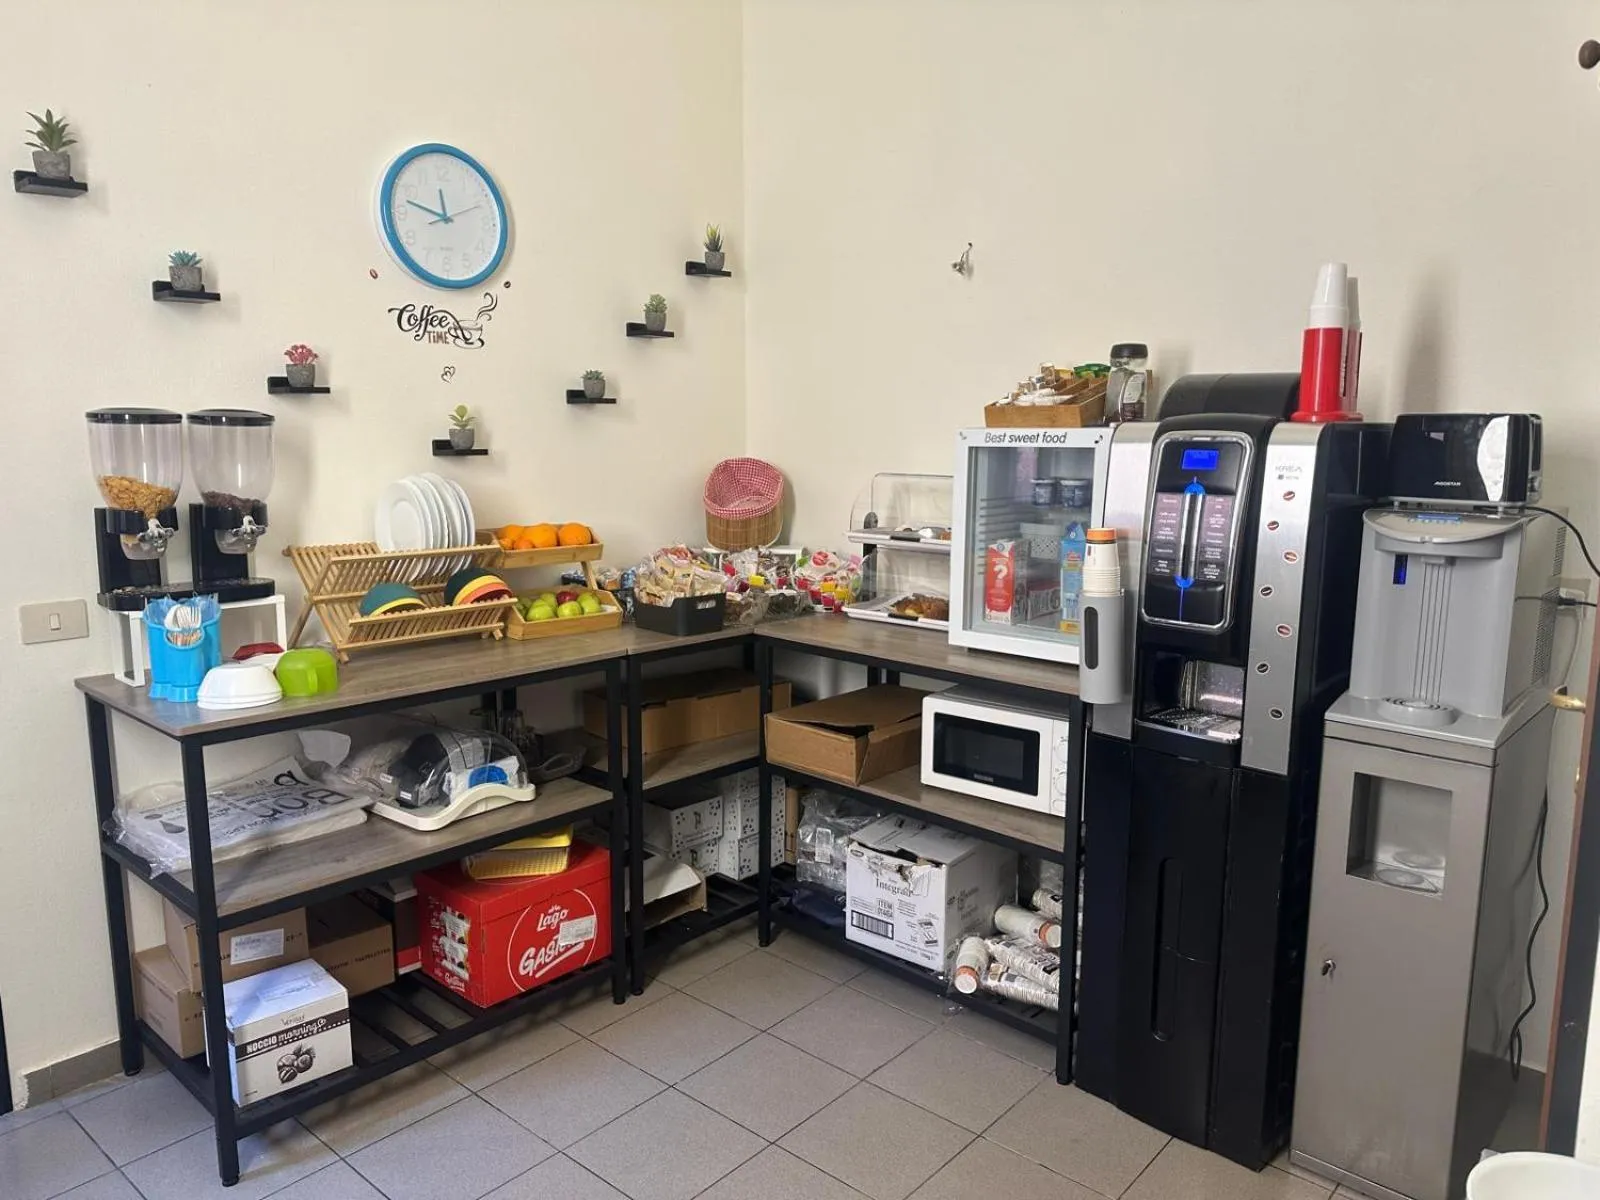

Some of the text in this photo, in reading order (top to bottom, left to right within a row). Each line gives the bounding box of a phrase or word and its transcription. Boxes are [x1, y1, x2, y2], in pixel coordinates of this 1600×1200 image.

[388, 304, 451, 341] Coffee
[984, 432, 1067, 443] Best sweet food
[536, 908, 569, 932] Lago
[246, 1022, 318, 1054] NOCCIO morning
